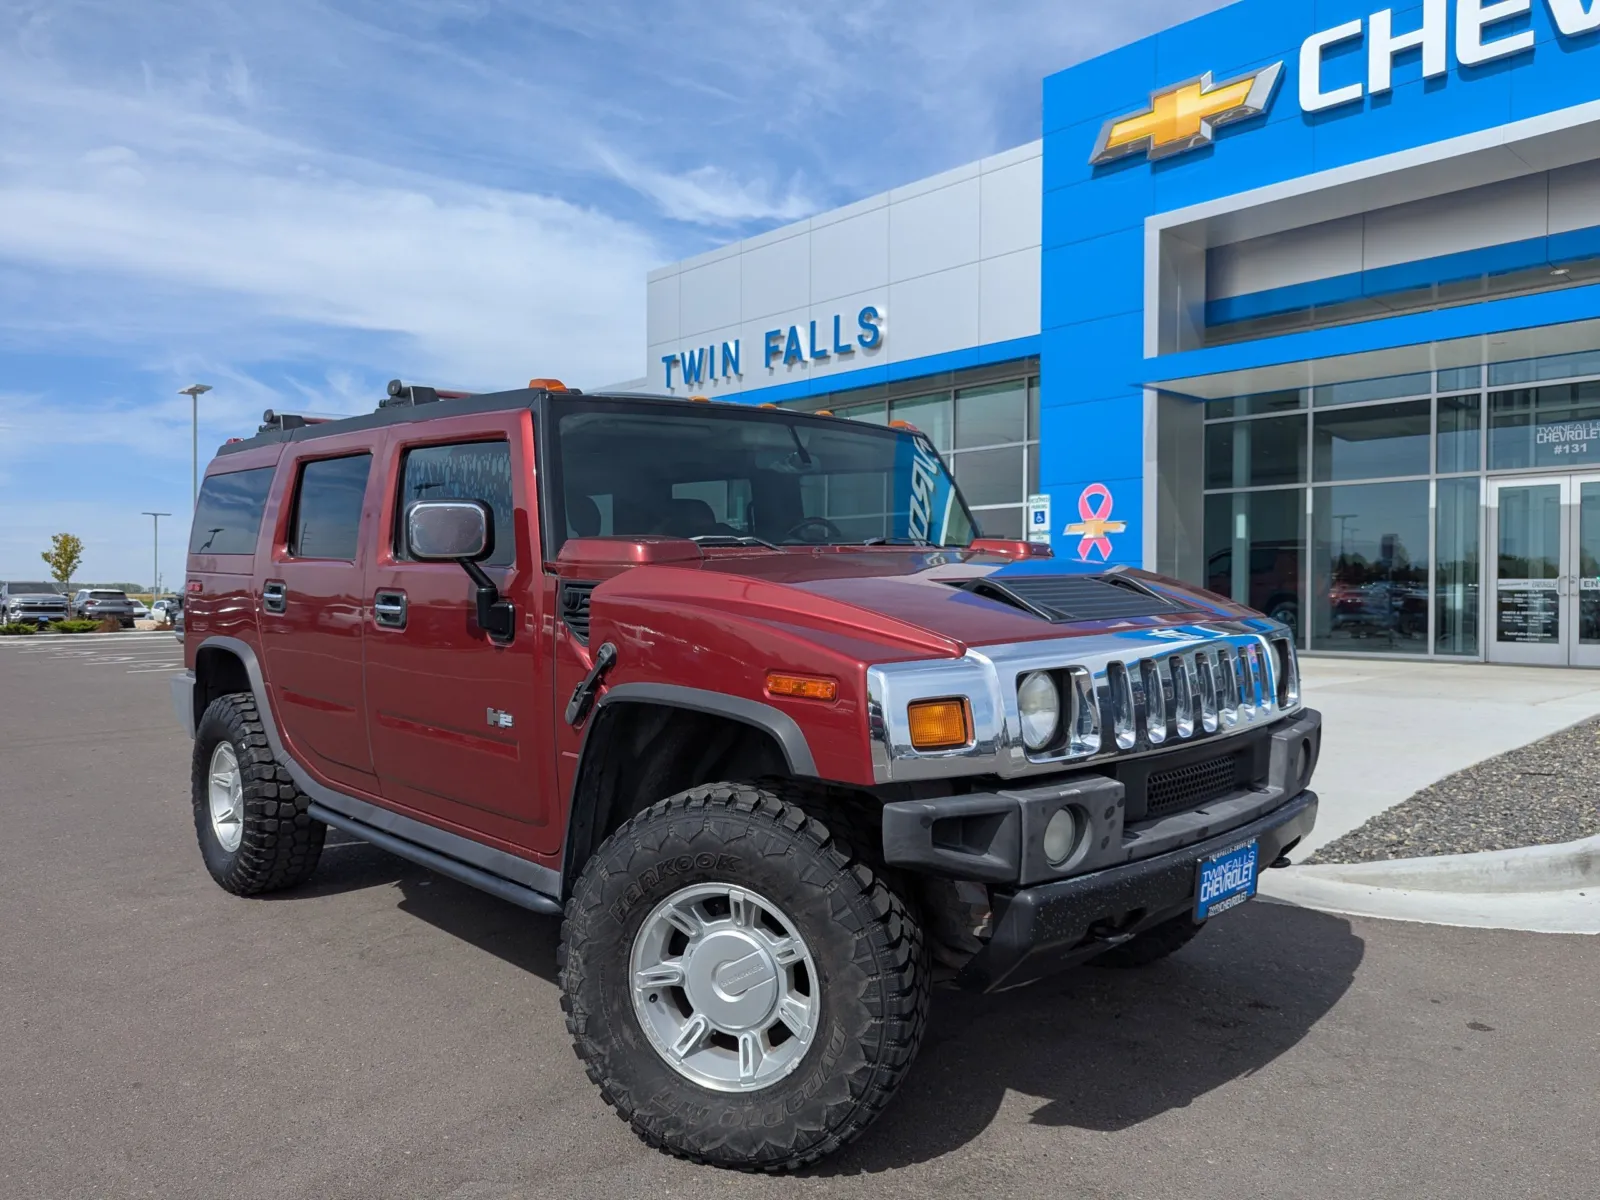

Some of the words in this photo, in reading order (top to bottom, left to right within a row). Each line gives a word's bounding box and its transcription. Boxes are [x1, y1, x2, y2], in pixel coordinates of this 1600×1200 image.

[661, 339, 740, 388] TWIN
[764, 306, 882, 368] FALLS
[1554, 443, 1587, 455] #131
[487, 707, 513, 728] H2
[1200, 861, 1255, 902] CHEVROLET
